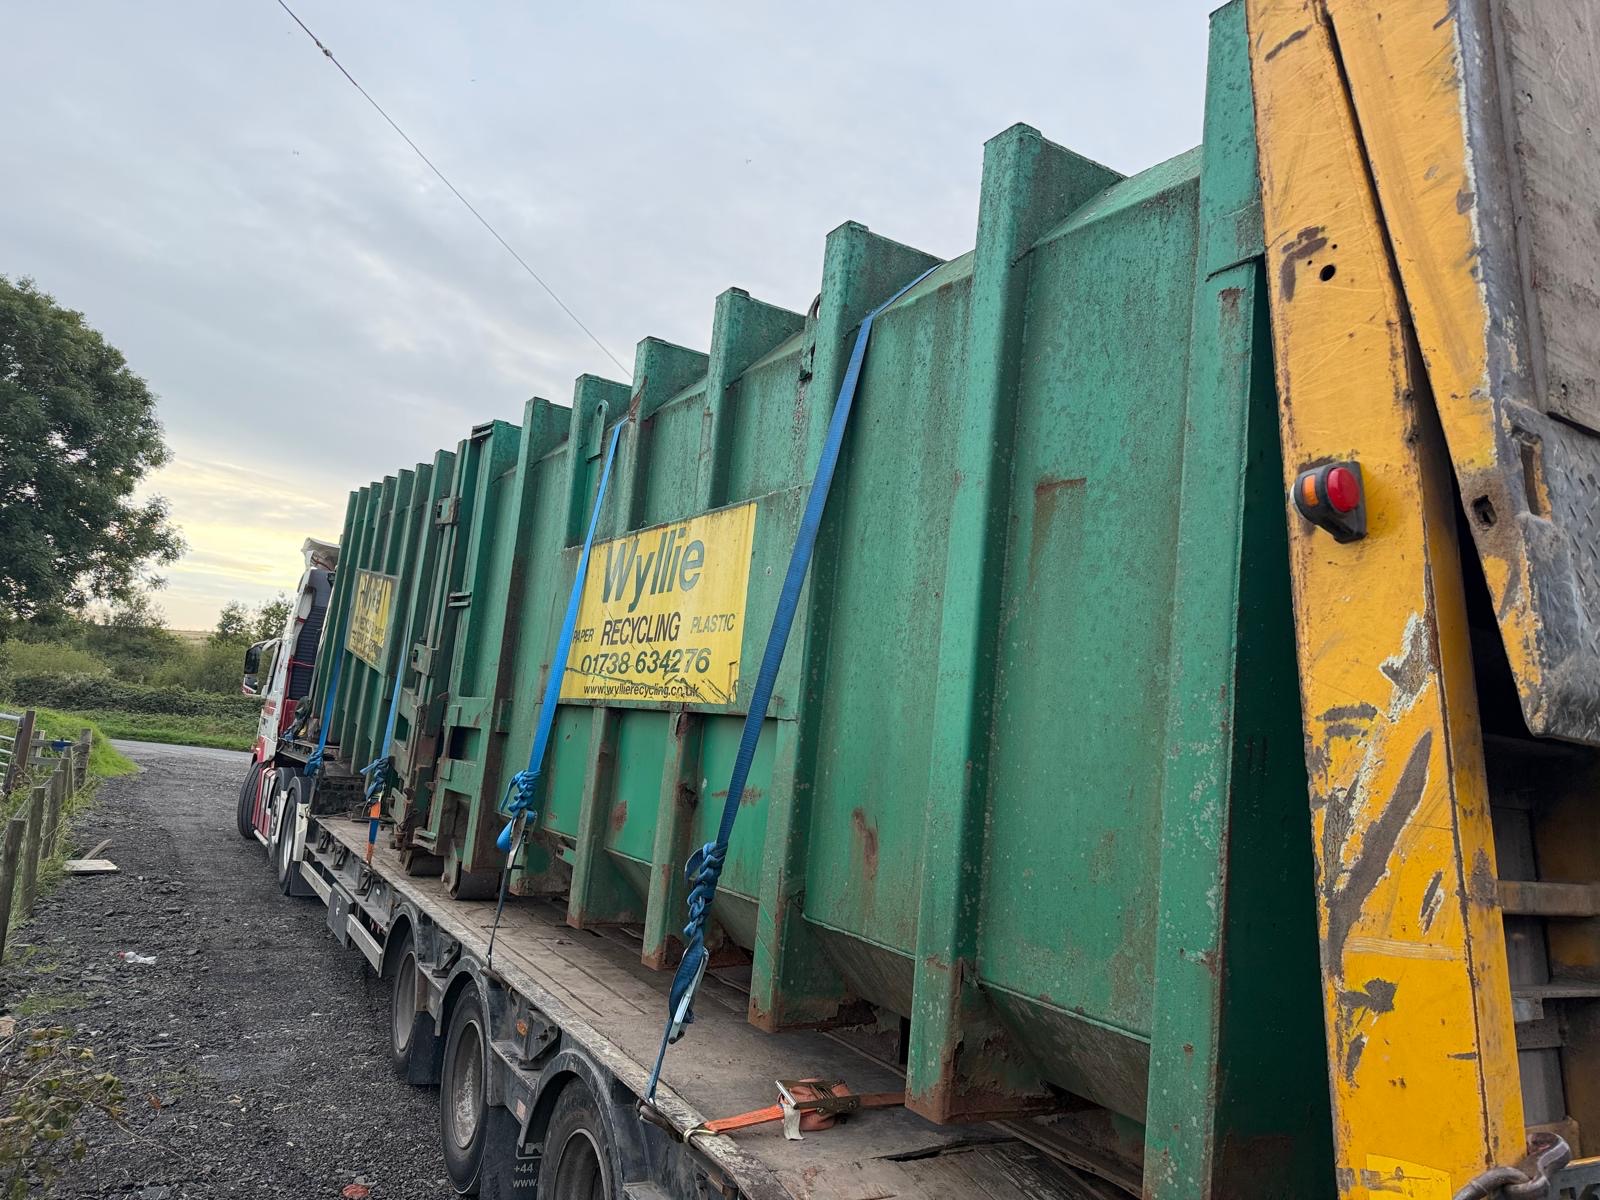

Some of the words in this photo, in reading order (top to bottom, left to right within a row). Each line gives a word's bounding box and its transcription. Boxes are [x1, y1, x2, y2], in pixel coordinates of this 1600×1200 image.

[602, 527, 705, 613] Wyllie
[573, 628, 594, 644] PAPER
[600, 611, 681, 646] RECYCLING
[690, 613, 735, 634] PLASTIC
[581, 652, 630, 675] 01738
[635, 647, 711, 674] 634276
[583, 682, 700, 698] www.wyllierecycling.co.uk
[513, 1163, 533, 1173] +44
